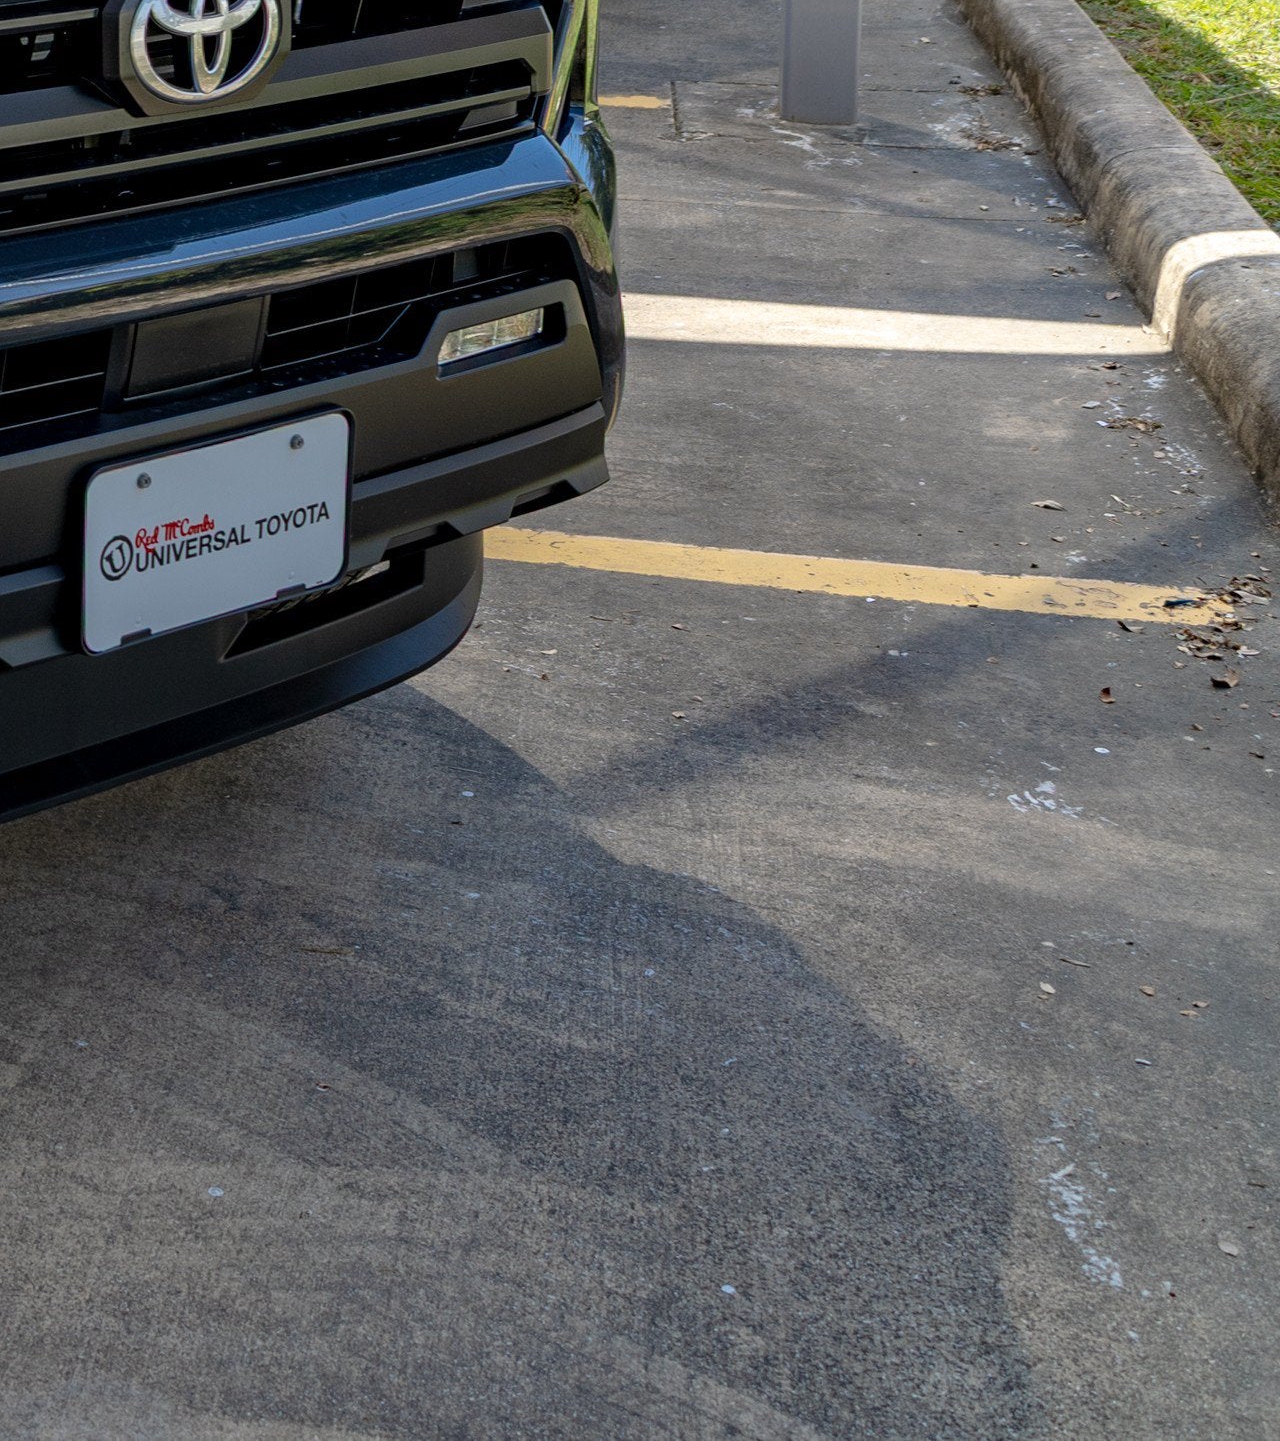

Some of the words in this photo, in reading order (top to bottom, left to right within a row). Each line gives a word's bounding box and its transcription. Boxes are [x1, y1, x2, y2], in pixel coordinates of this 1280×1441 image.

[135, 526, 159, 550] Red
[161, 513, 215, 542] McCombs
[136, 525, 251, 572] UNIVERSAL
[254, 501, 330, 539] TOYOTA
